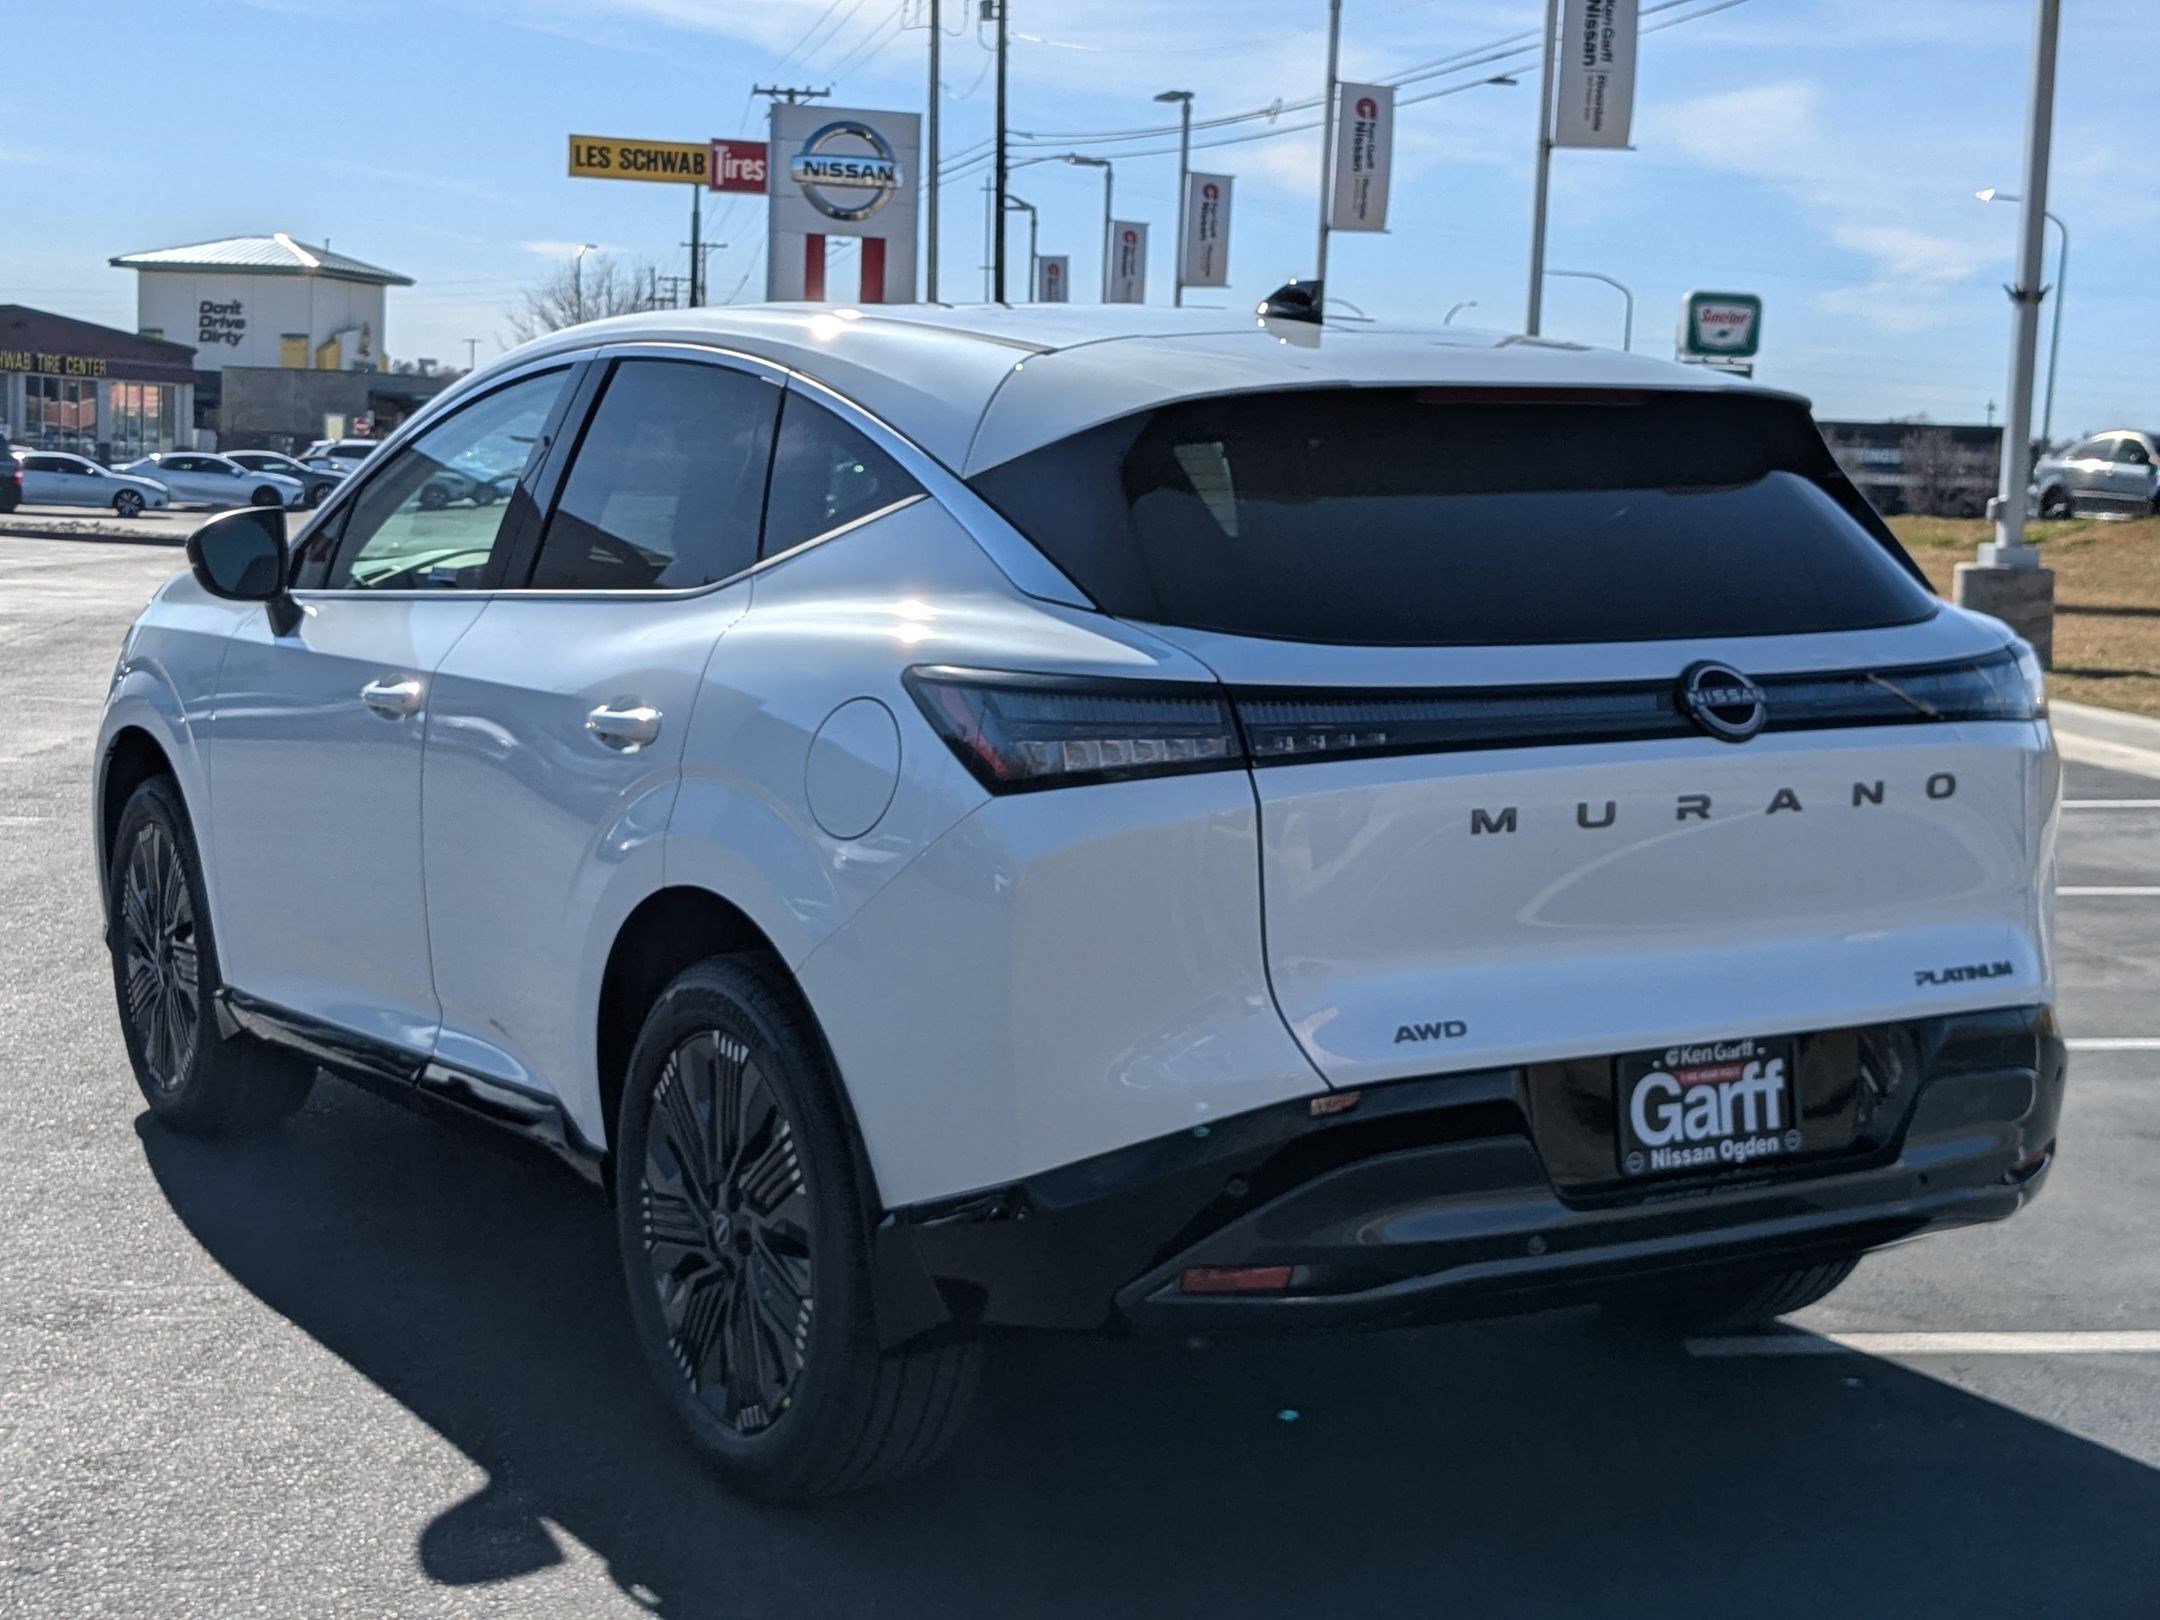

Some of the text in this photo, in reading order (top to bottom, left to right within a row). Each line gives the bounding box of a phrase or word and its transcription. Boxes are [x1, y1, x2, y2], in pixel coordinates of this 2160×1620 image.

[1583, 0, 1602, 66] Nissan
[1600, 27, 1616, 62] Garff
[575, 145, 766, 185] LES SCHWAB Tires
[803, 161, 895, 181] NISSAN
[200, 299, 242, 315] Don't
[199, 314, 246, 329] Drive
[199, 329, 245, 348] Dirty
[37, 353, 60, 373] TIRE
[65, 356, 107, 376] CENTER
[1687, 688, 1766, 706] NISSAN
[1471, 773, 1957, 834] MURANO
[1914, 960, 2013, 986] PLATINUM
[1394, 1020, 1467, 1044] AWD
[1681, 1044, 1712, 1066] Ken
[1714, 1039, 1755, 1061] Garff
[1630, 1058, 1785, 1147] Garff
[1652, 1145, 1716, 1169] Nissan
[1720, 1135, 1779, 1163] Ogden
